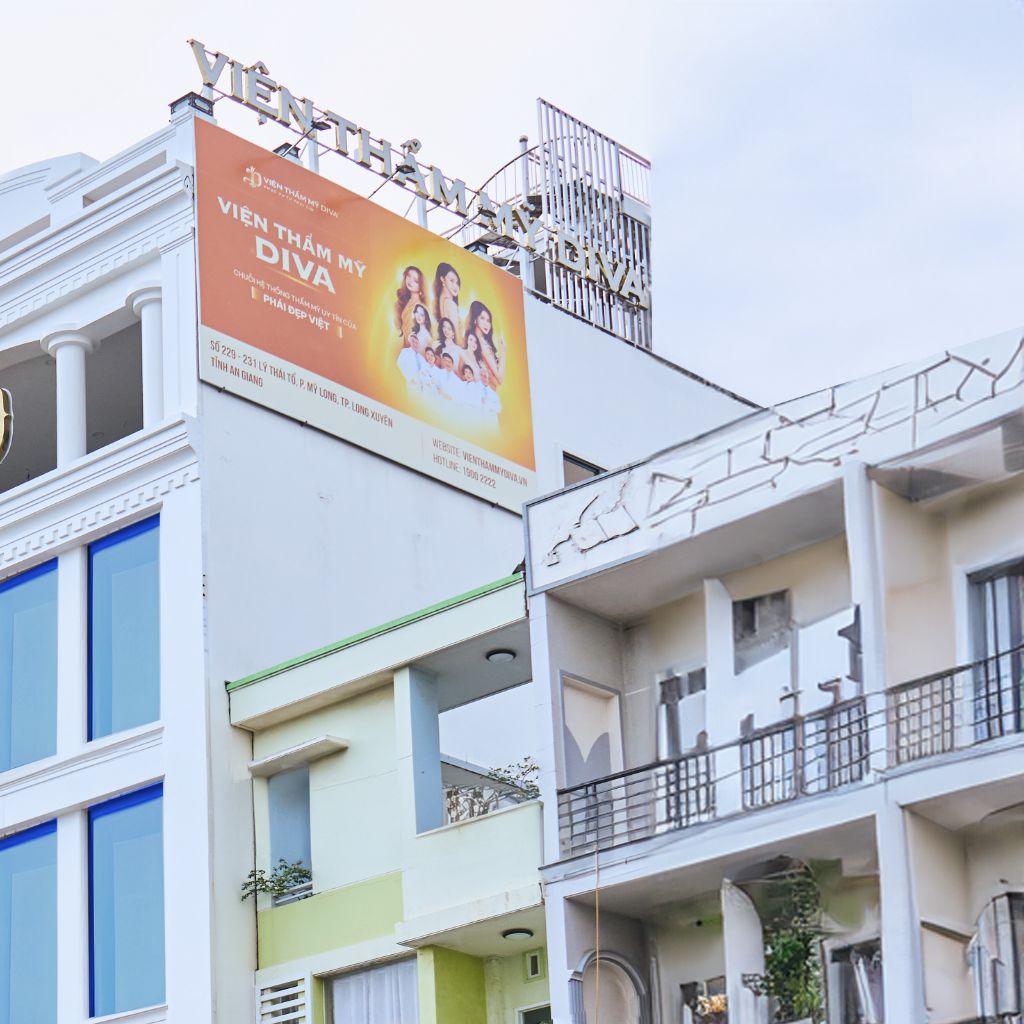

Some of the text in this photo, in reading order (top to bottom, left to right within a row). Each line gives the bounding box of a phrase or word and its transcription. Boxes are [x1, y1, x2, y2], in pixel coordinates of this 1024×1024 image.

[186, 38, 316, 139] VIỆN
[548, 229, 650, 311] DIVA
[217, 196, 269, 233] VIỆN
[273, 222, 332, 263] THẨM
[338, 254, 367, 279] MỸ
[255, 235, 337, 294] DIVA
[263, 294, 330, 331] PHÁI ĐẸP VIỆT
[229, 365, 240, 378] AN
[241, 370, 264, 388] GIANG
[242, 354, 257, 368] 231
[351, 402, 370, 418] LONG
[370, 410, 393, 428] XUYÊN
